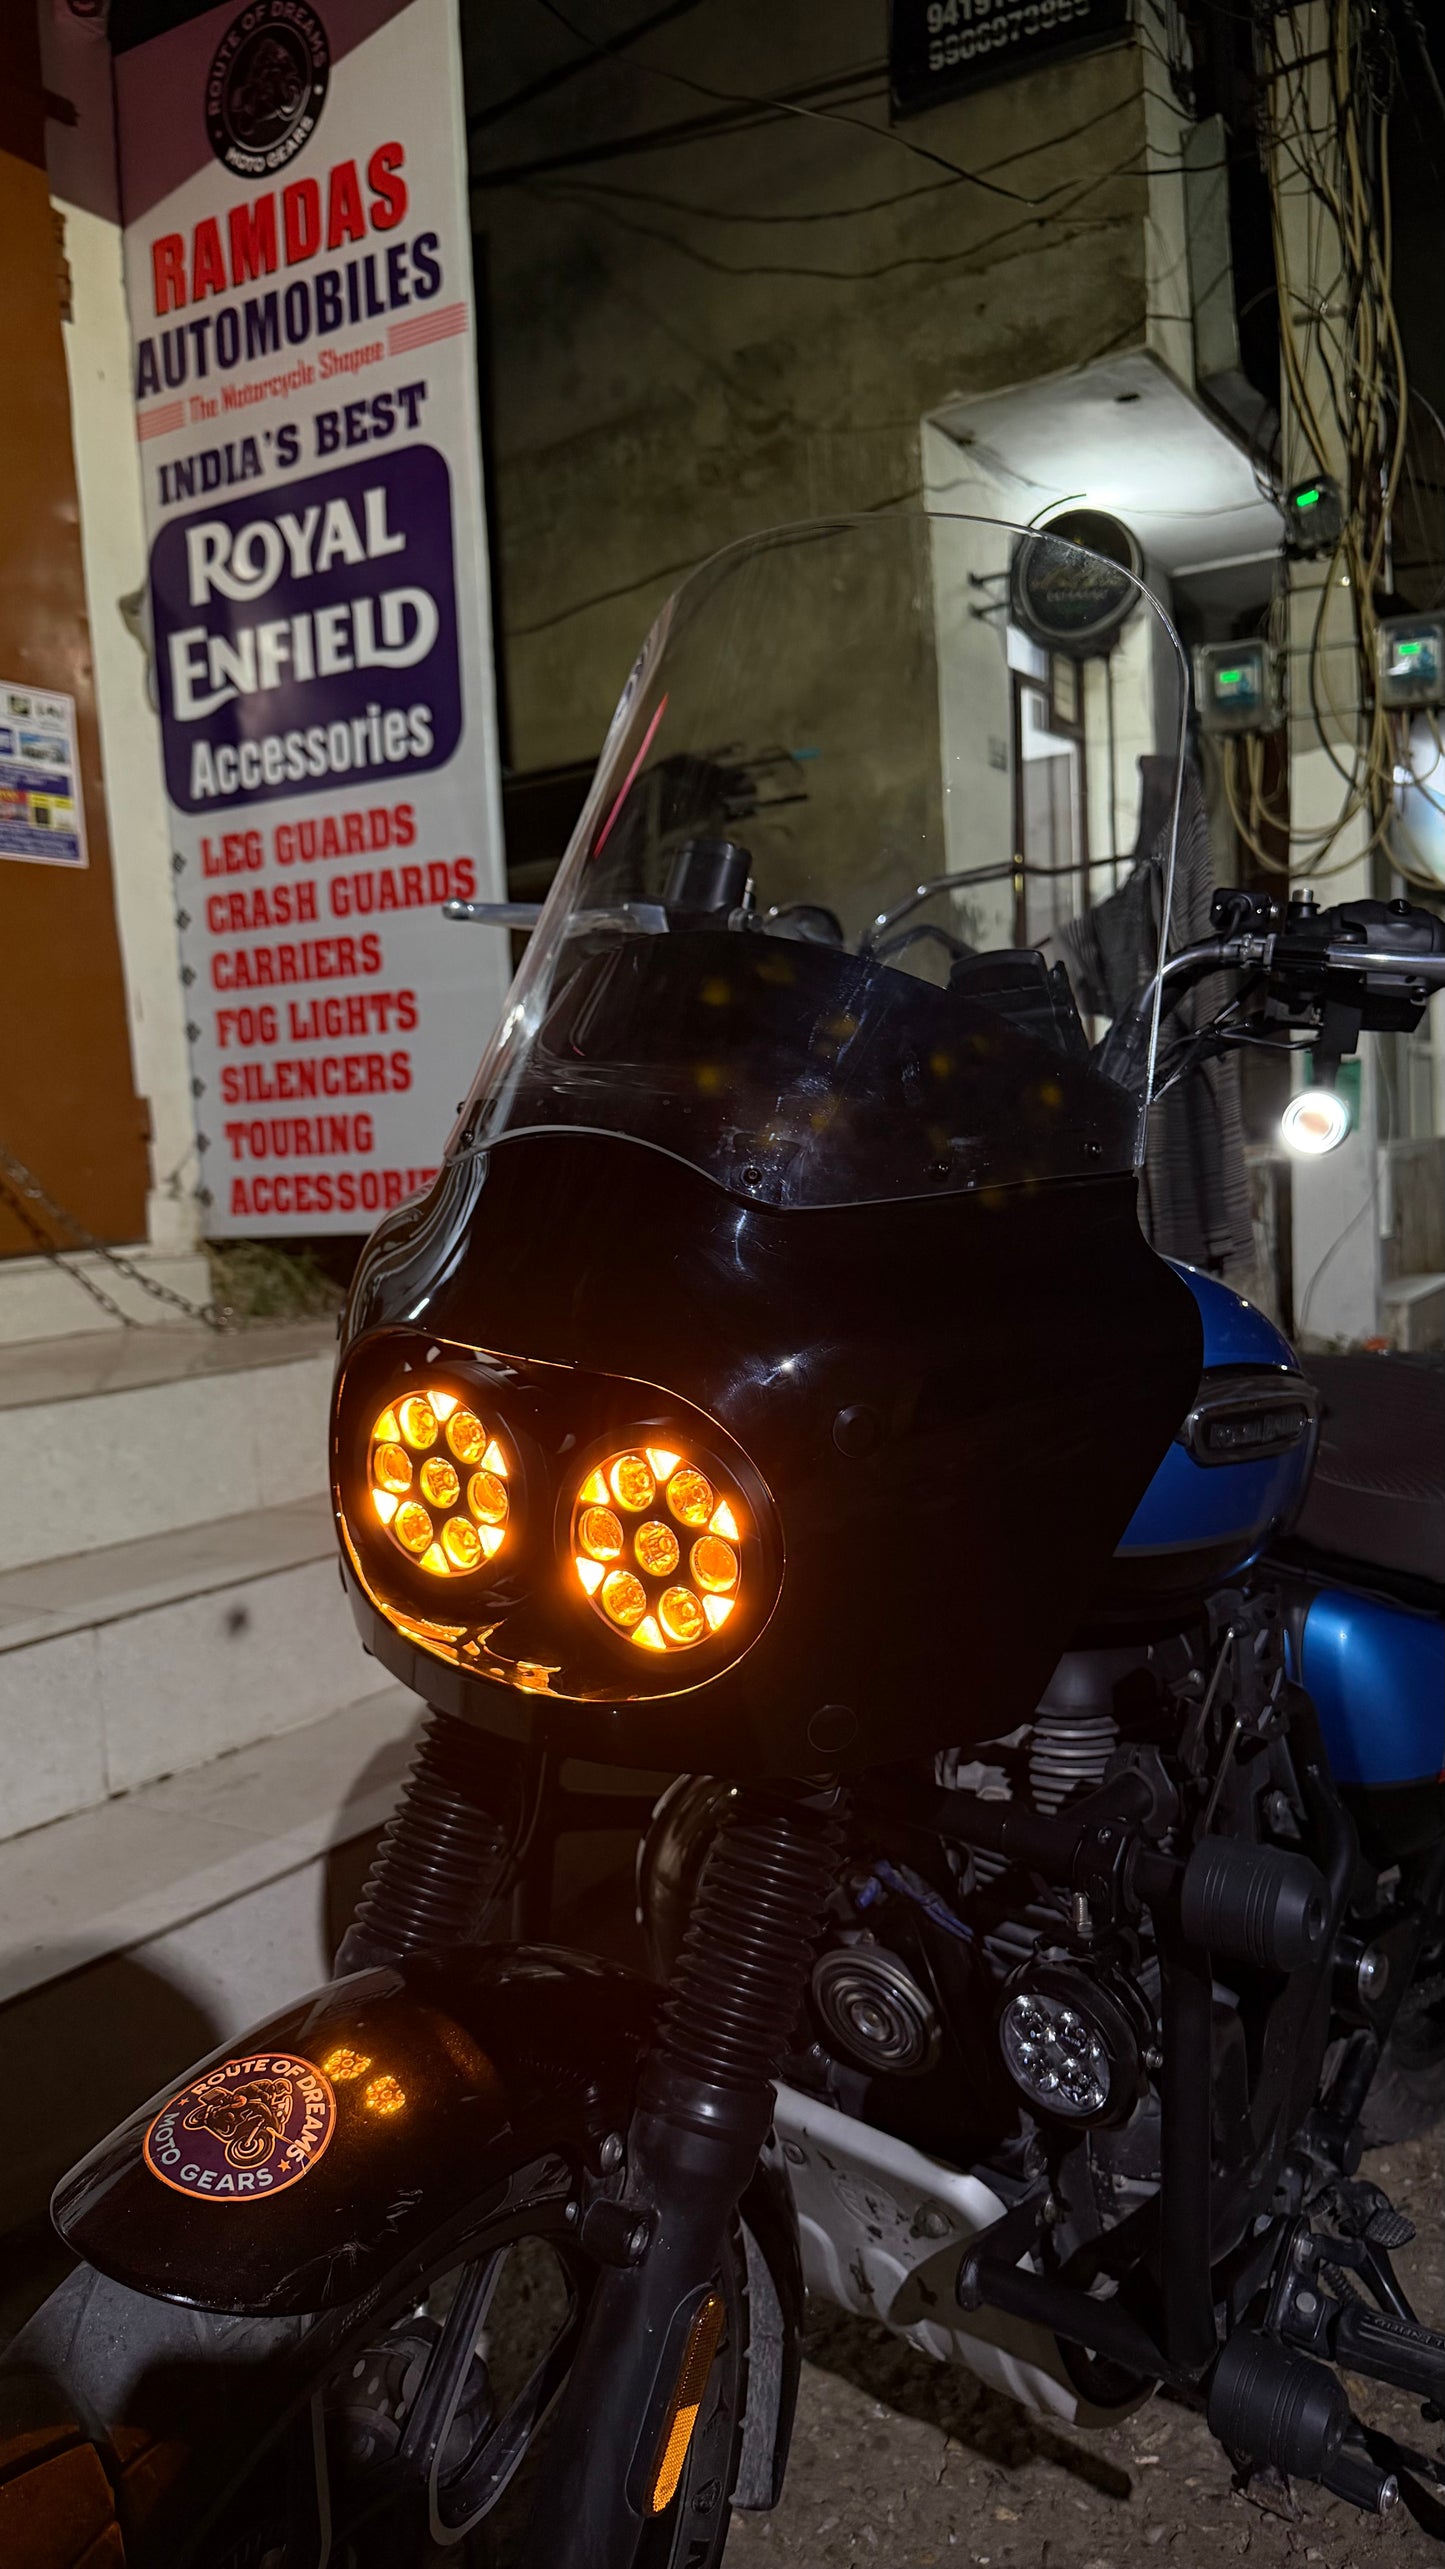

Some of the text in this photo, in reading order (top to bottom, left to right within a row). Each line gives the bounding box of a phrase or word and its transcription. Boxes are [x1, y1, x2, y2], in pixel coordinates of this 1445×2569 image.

[207, 0, 328, 116] ROUTE OF DREAMS
[266, 115, 315, 169] GEARS
[151, 141, 409, 317] RAMDAS
[136, 231, 442, 400] AUTOMOBILES
[189, 394, 218, 423] The
[220, 359, 316, 413] Motorcycle
[158, 381, 428, 506] INDIA'S BEST
[185, 486, 406, 607] ROYAL
[167, 586, 440, 722] ENFIELD
[190, 702, 433, 800] Accessories
[201, 804, 417, 879] LEG GUARDS
[205, 856, 478, 935] CRASH GUARDS
[211, 933, 383, 993] CARRIERS
[215, 989, 419, 1048] FOG LIGHTS
[220, 1050, 413, 1106] SILENCERS
[223, 1112, 375, 1161] TOURING
[191, 2058, 326, 2163] ROUTE OF DREAMS
[154, 2111, 274, 2192] MOTO GEARS
